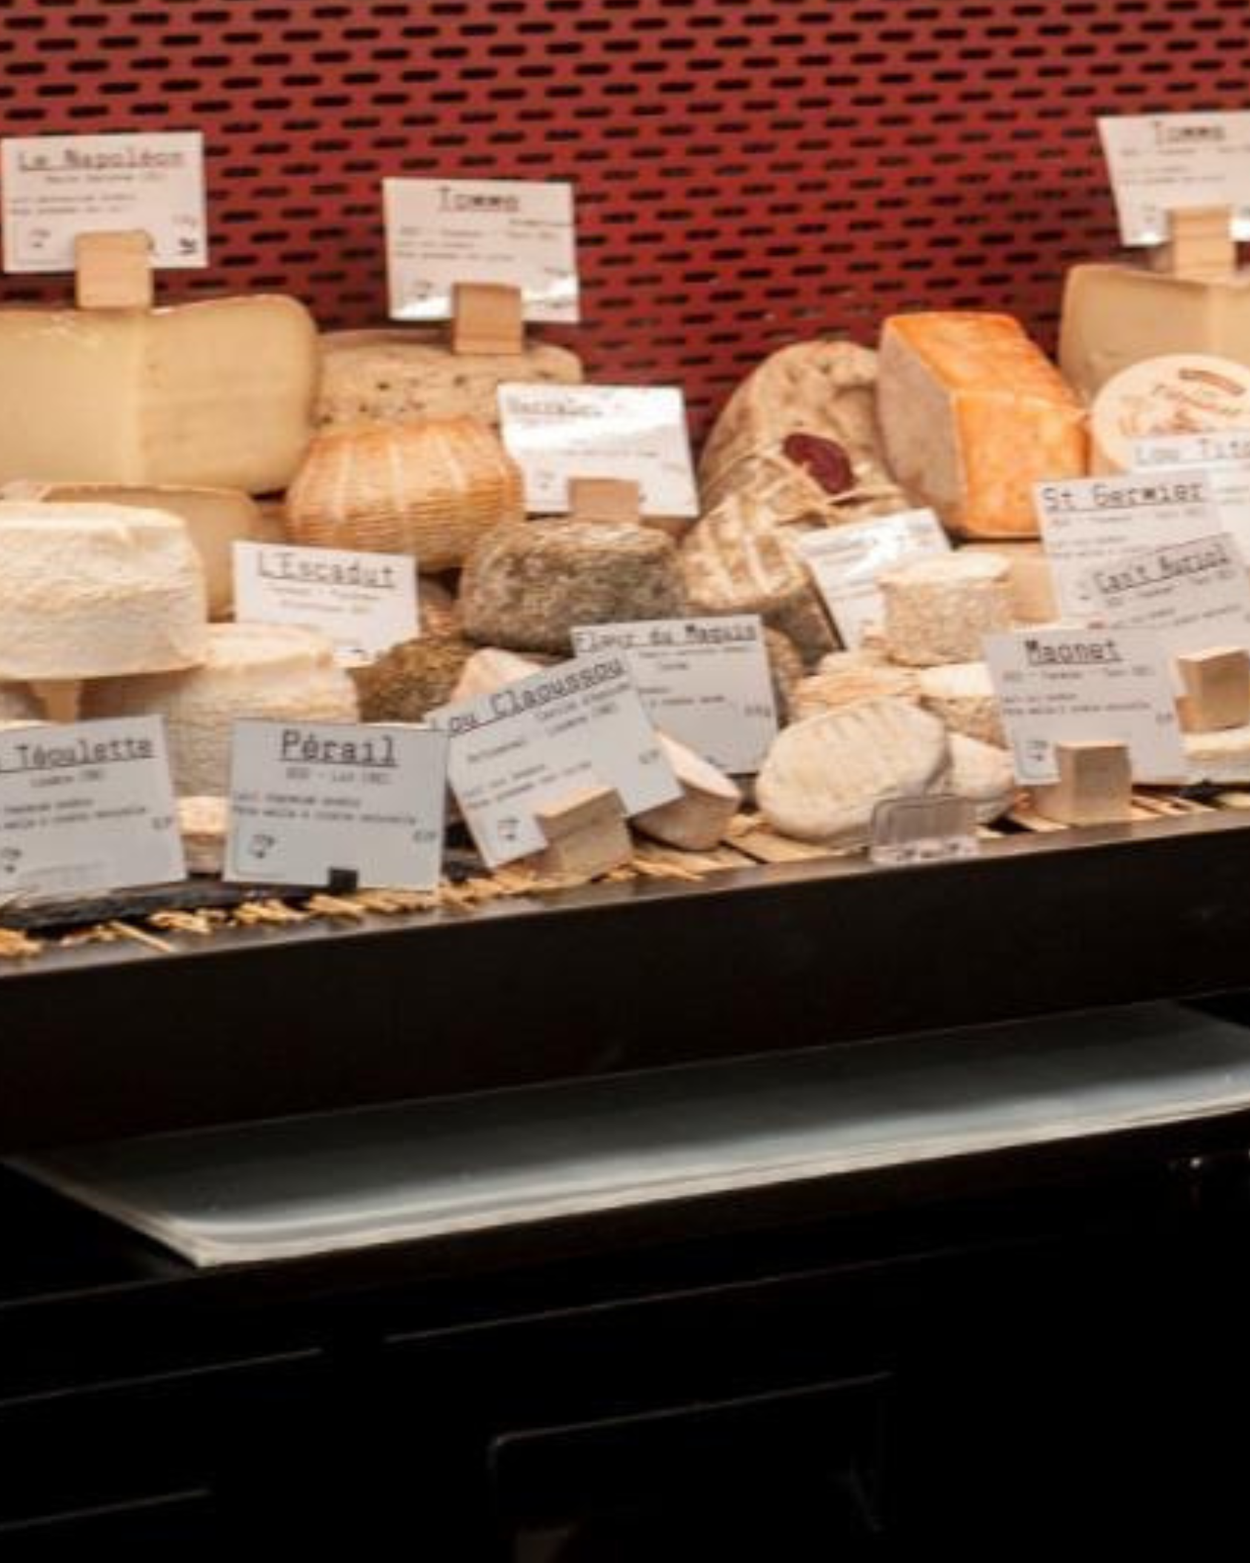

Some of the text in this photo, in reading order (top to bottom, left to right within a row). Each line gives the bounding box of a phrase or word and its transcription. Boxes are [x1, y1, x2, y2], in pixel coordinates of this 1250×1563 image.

[1044, 487, 1077, 511] St
[1026, 639, 1124, 665] Magnet
[281, 728, 398, 766] Pérail
